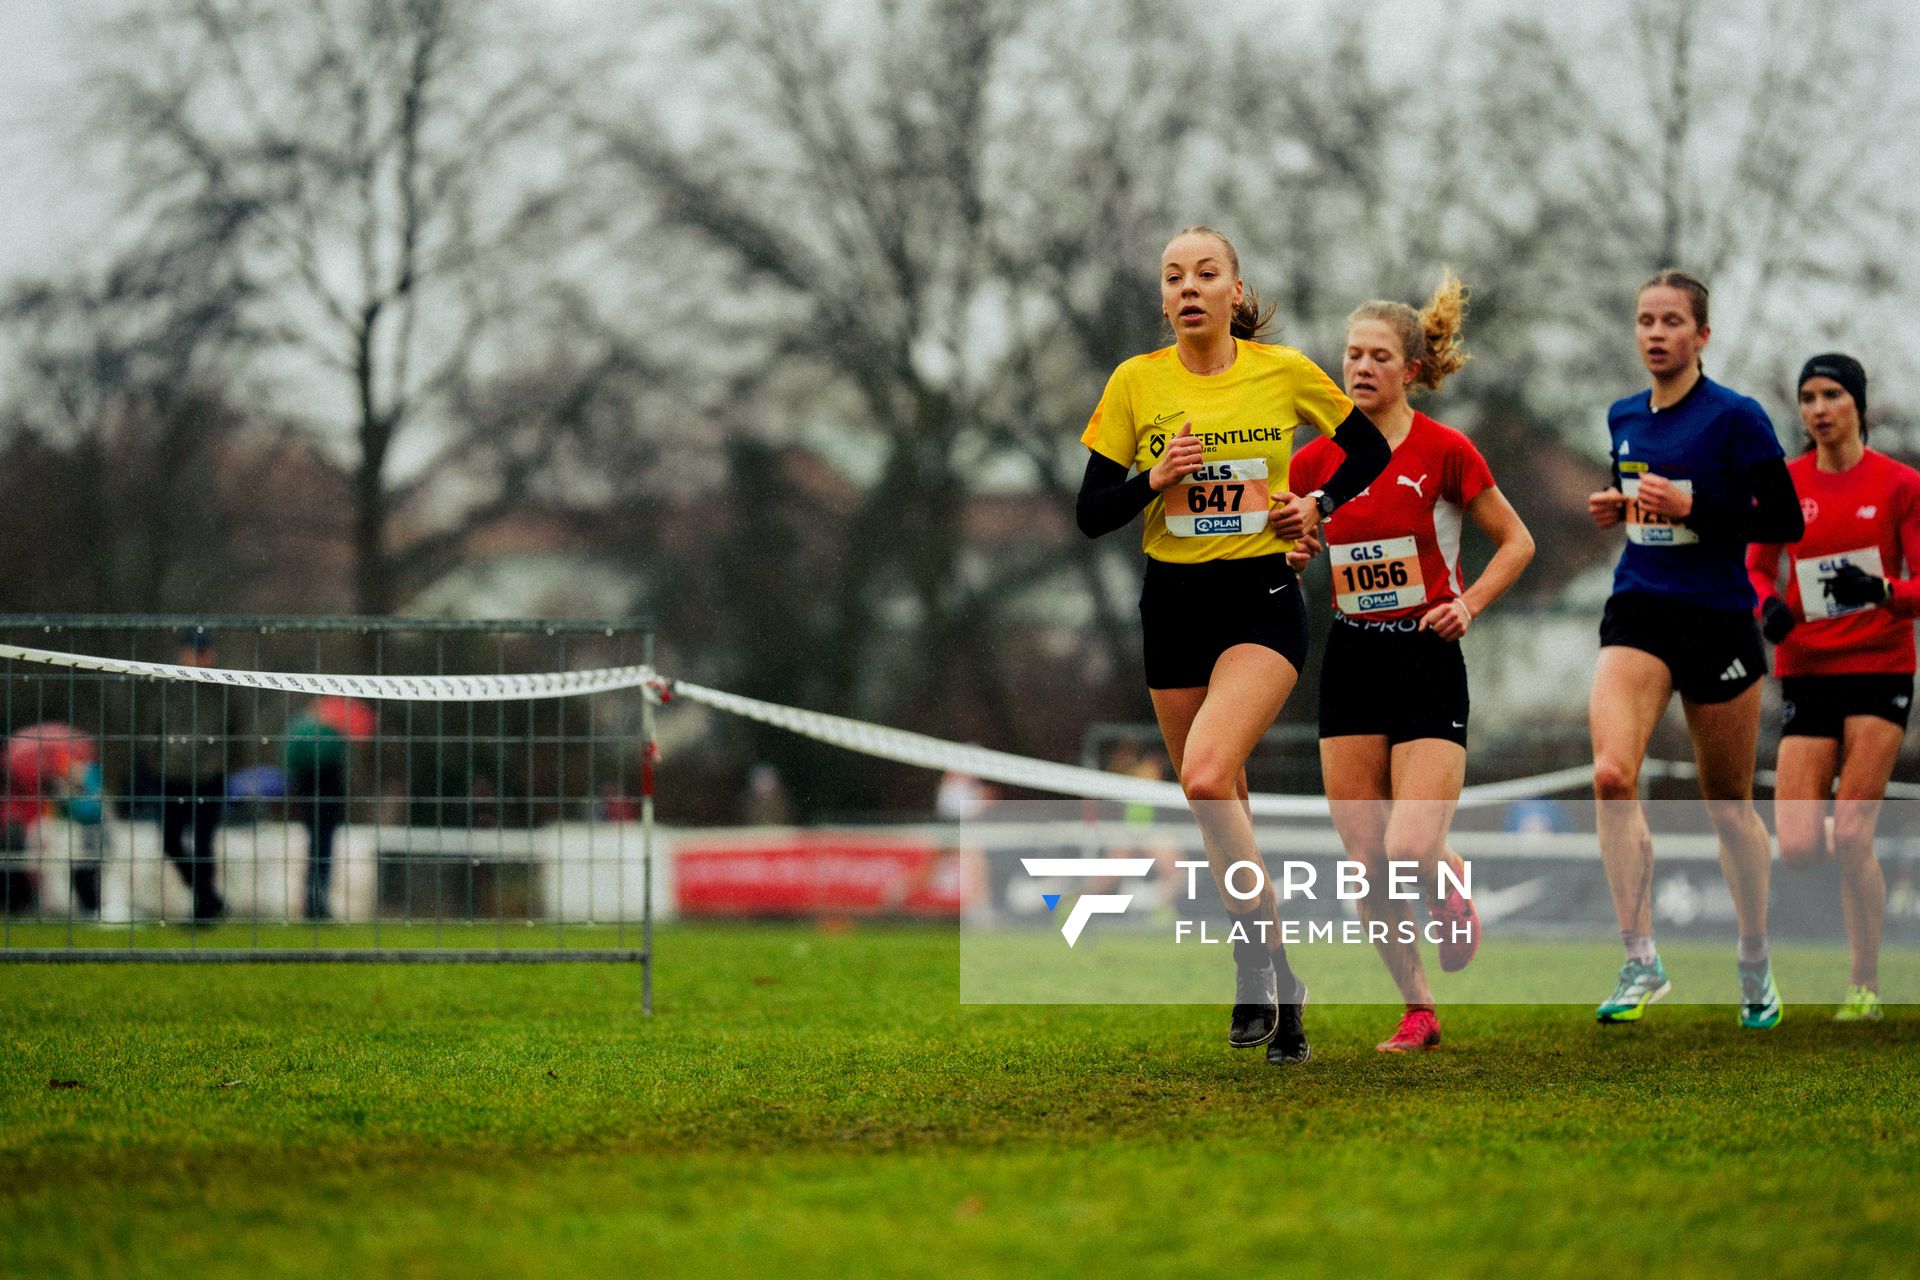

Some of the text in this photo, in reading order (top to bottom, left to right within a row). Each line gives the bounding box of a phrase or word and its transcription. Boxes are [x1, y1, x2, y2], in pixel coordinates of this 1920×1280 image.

[1187, 484, 1245, 513] 647
[1213, 518, 1241, 528] PLAN
[1342, 561, 1408, 592] 1056
